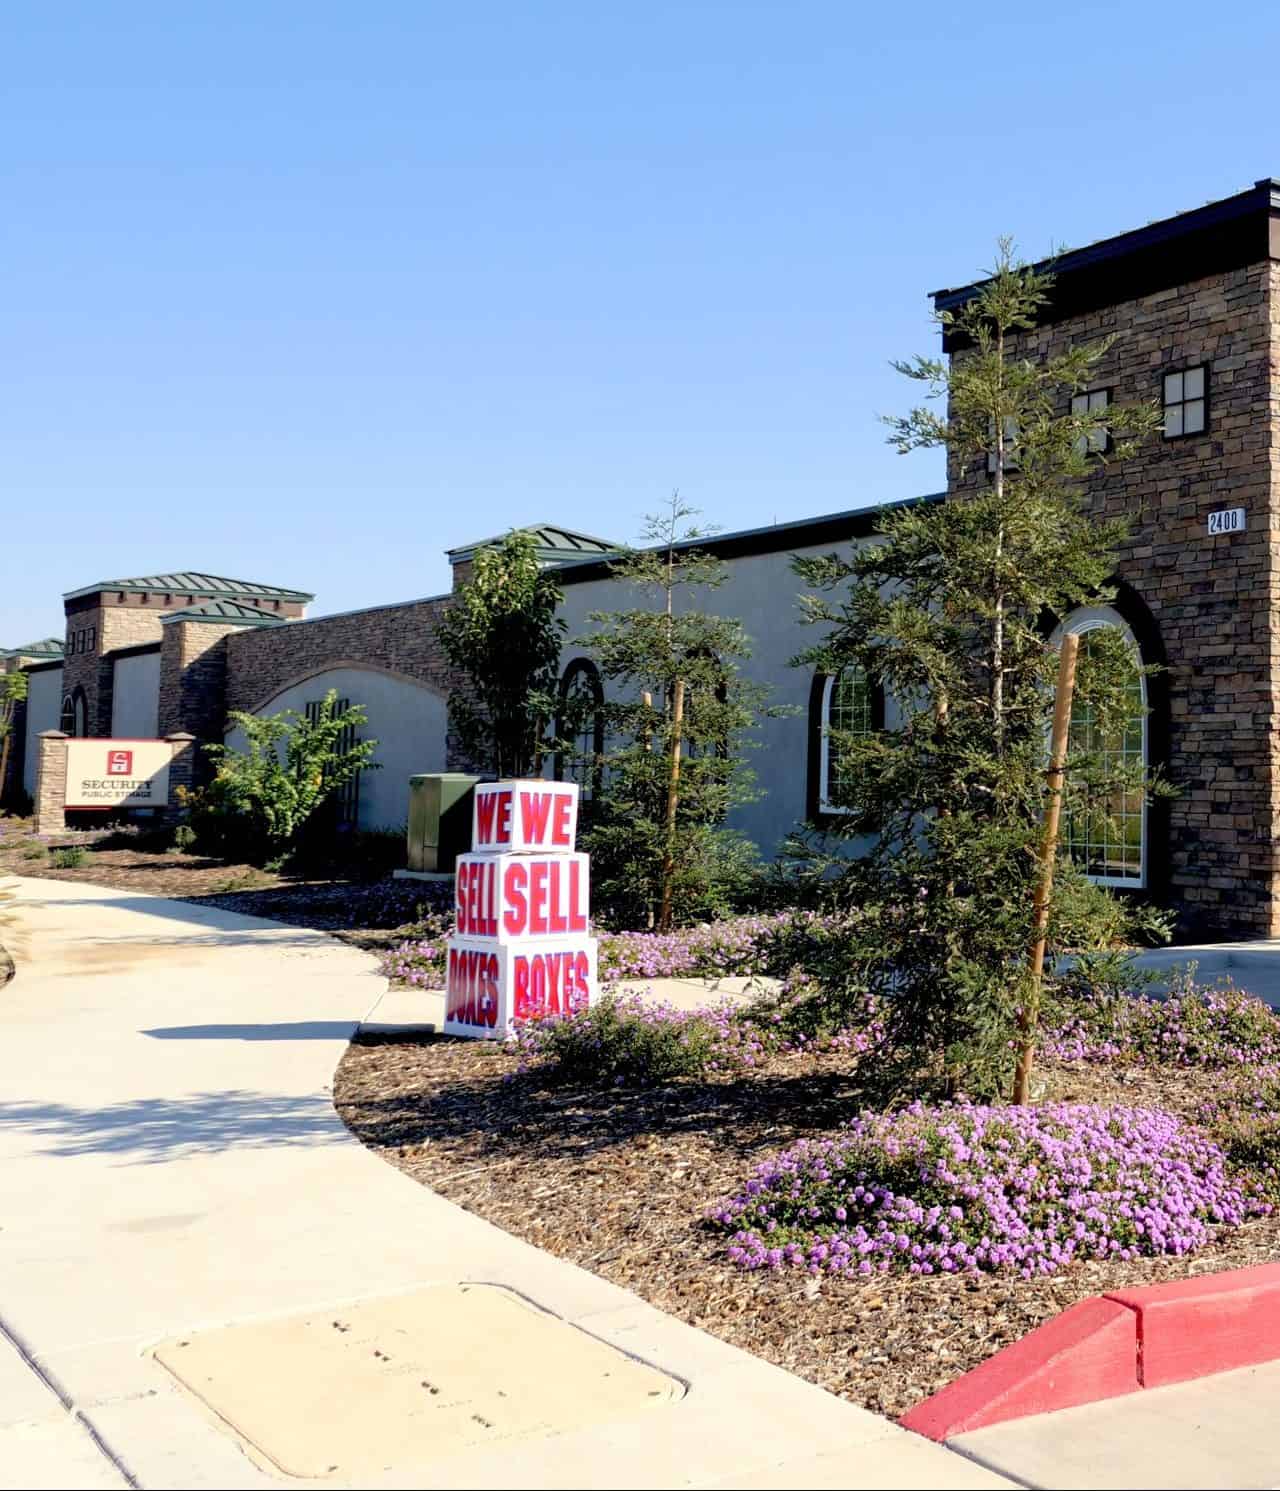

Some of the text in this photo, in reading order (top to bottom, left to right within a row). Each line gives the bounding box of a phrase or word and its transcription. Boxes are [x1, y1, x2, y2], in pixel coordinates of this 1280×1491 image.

[1210, 511, 1238, 533] 2400
[81, 780, 153, 789] SECURITY
[477, 791, 513, 844] WE
[520, 792, 572, 845] WE
[457, 862, 499, 937] SELL
[504, 861, 587, 936] SELL
[513, 950, 590, 1021] BOXES
